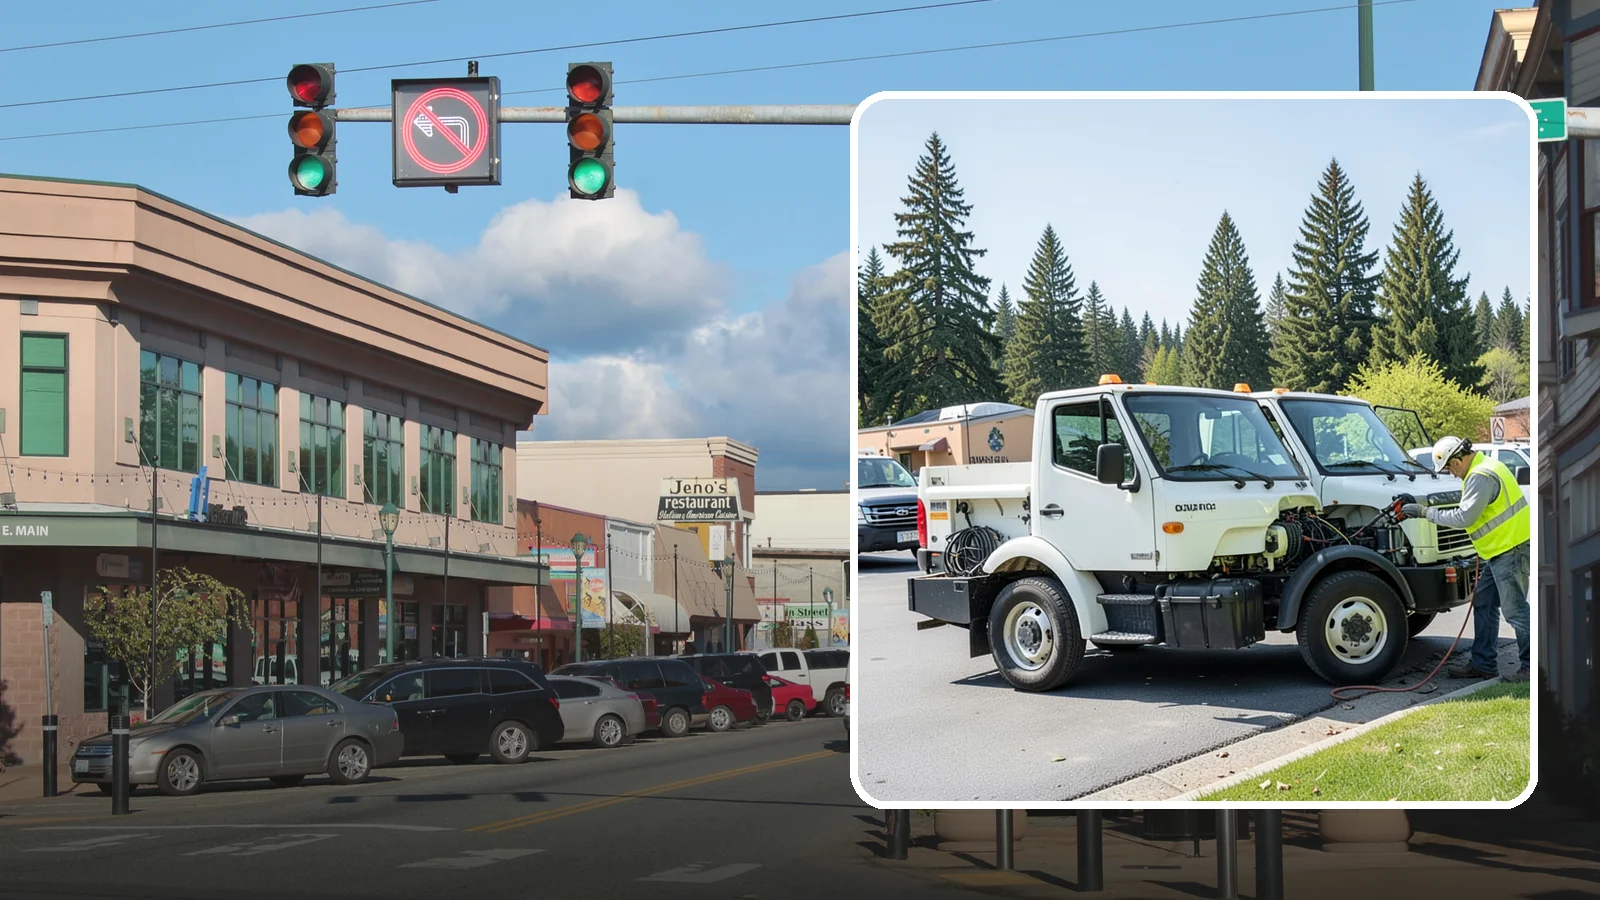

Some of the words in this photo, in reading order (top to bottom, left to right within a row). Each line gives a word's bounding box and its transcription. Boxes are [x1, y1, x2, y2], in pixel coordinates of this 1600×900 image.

[670, 480, 727, 494] Jeno's
[665, 496, 731, 509] restaurant
[658, 510, 681, 519] Italian
[686, 510, 714, 519] American
[715, 509, 737, 519] Cuisine
[2, 525, 13, 536] E.
[15, 525, 49, 536] MAIN
[798, 608, 828, 616] Street
